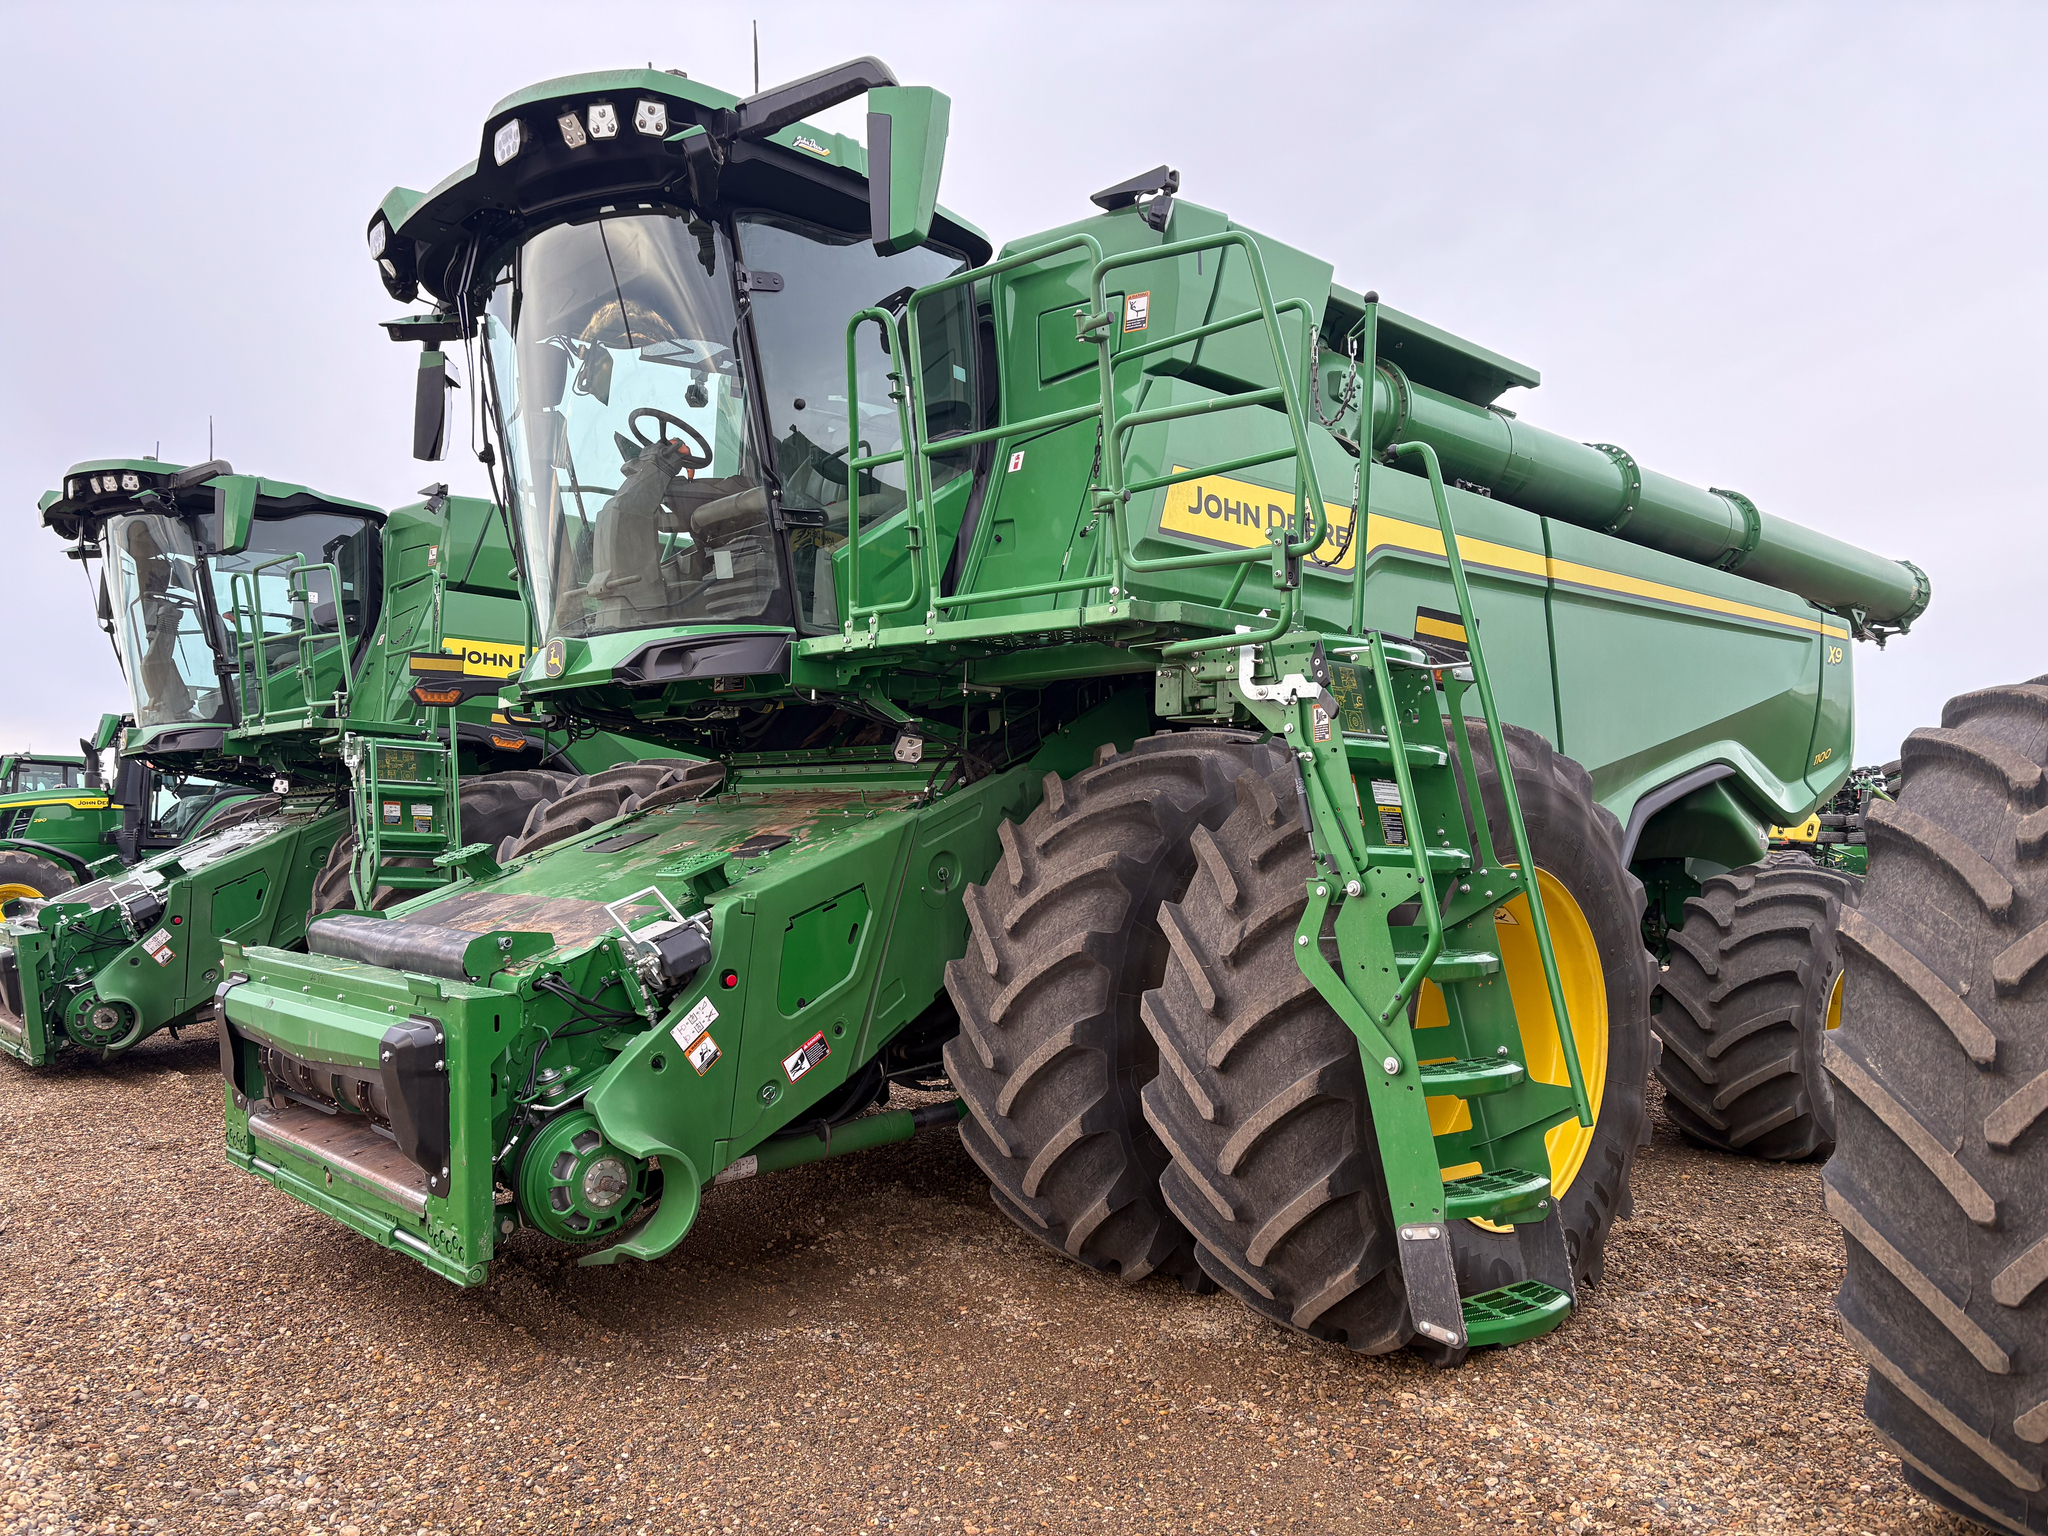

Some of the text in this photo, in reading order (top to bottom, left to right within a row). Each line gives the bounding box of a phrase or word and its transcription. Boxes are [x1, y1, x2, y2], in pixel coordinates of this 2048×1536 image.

[1188, 485, 1261, 530] JOHN
[462, 647, 514, 669] JOHN
[1827, 645, 1843, 665] X9
[1813, 747, 1832, 767] 1100
